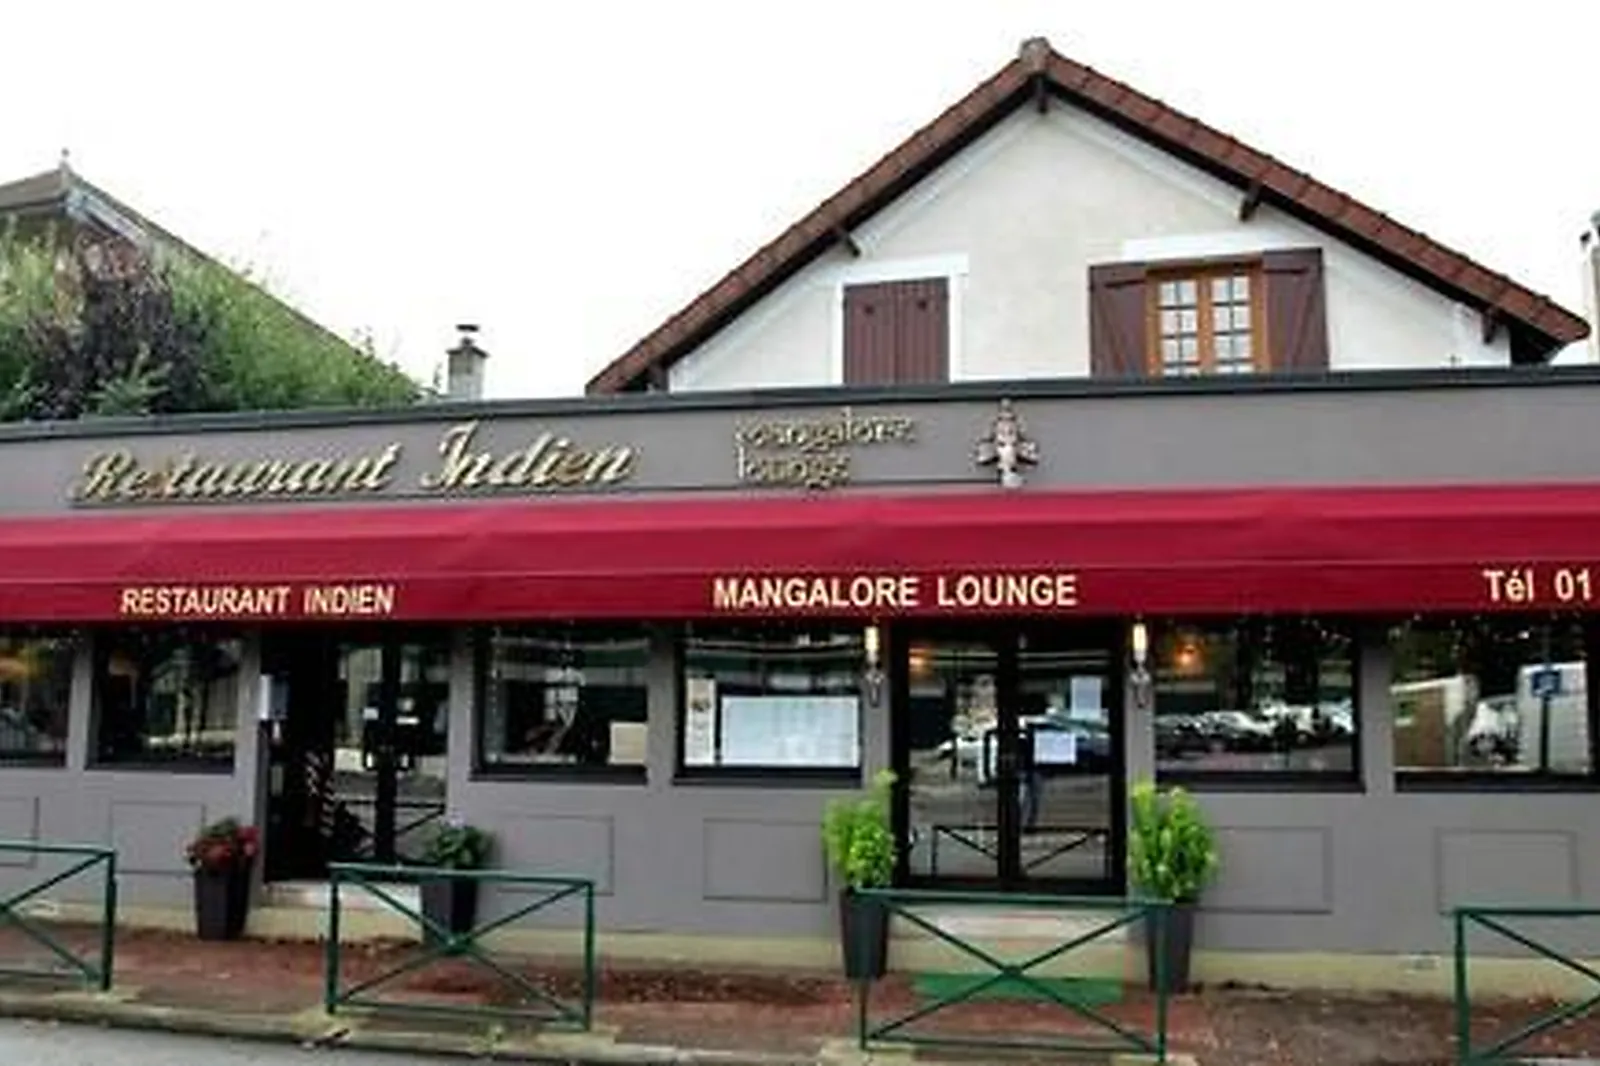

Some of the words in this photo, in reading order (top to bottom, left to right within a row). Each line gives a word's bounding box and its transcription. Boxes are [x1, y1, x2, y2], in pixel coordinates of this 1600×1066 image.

[70, 442, 400, 501] Restaurant
[421, 421, 640, 491] Indien
[120, 587, 290, 616] RESTAURANT
[303, 585, 395, 615] INDIEN
[712, 576, 921, 609] MANGALORE
[936, 574, 1078, 607] LOUNGE
[1482, 568, 1535, 602] Tél
[1554, 568, 1592, 602] 01
